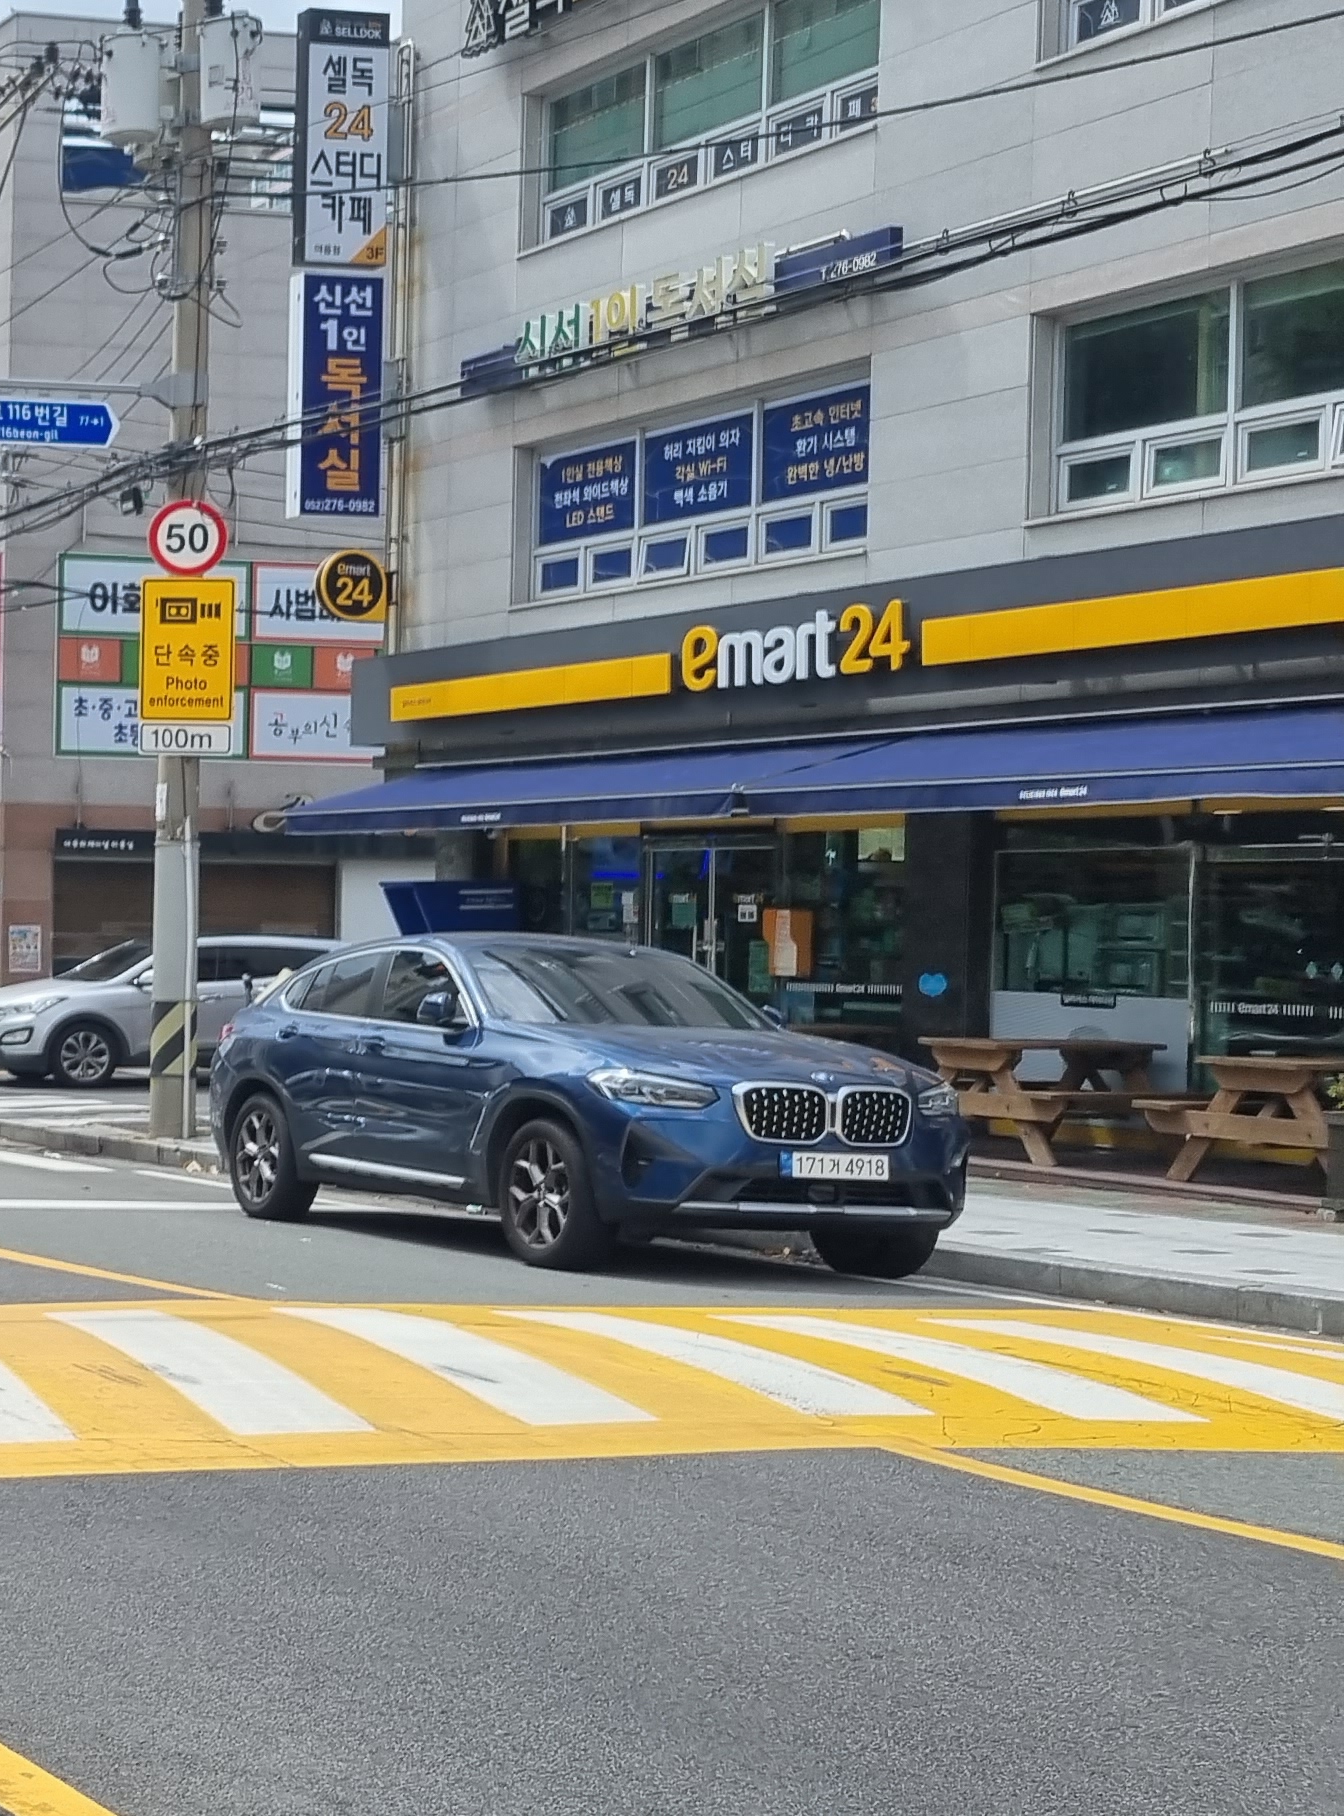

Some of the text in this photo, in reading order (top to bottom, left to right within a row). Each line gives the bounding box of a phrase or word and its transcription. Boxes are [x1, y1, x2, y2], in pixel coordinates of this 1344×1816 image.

[322, 54, 374, 97] 셀독
[324, 101, 374, 142] 24
[310, 149, 382, 192] 스터디
[667, 164, 688, 190] 24
[321, 193, 373, 235] 카페
[366, 247, 385, 260] 3F
[313, 284, 374, 316] 신선
[320, 318, 367, 351] 1인
[318, 357, 368, 491] 독서실
[791, 399, 862, 433] 초고속 인터넷
[664, 440, 683, 461] 허리
[718, 426, 741, 449] 의자
[795, 425, 856, 458] 환기 시스템
[787, 460, 820, 485] 완벽한
[565, 509, 585, 529] LED
[165, 523, 210, 554] 50
[337, 562, 372, 577] emart
[336, 577, 374, 608] 24
[153, 644, 221, 668] 단속중
[681, 598, 912, 692] emart24
[165, 676, 208, 692] Photo
[148, 695, 225, 710] enforcement
[150, 728, 213, 749] 100m
[844, 1158, 885, 1177] 4918
